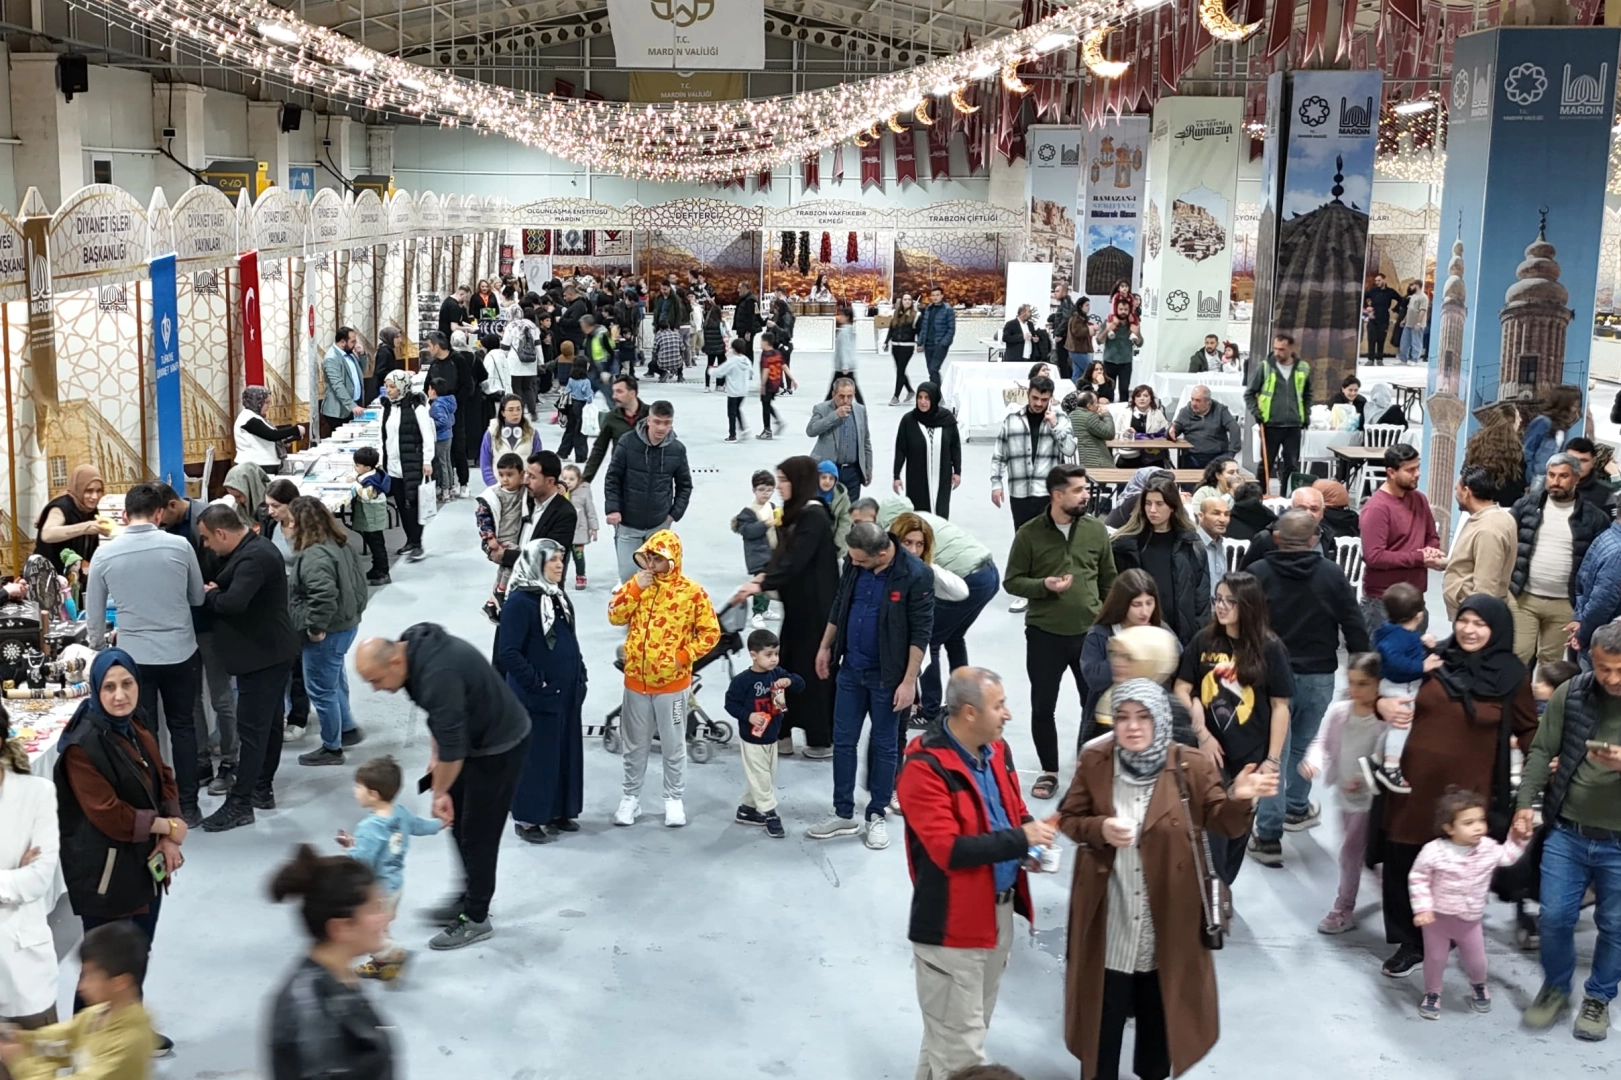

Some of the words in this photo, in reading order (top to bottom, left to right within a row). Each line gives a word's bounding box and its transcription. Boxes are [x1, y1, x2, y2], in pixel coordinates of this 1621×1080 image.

[676, 35, 690, 44] T.C.
[648, 48, 683, 56] MARDN
[685, 46, 719, 56] VALİLİĞİ
[76, 211, 109, 235] DİYANET
[109, 211, 131, 237] İŞLERİ
[83, 240, 127, 268] BAŞKANLIĞI
